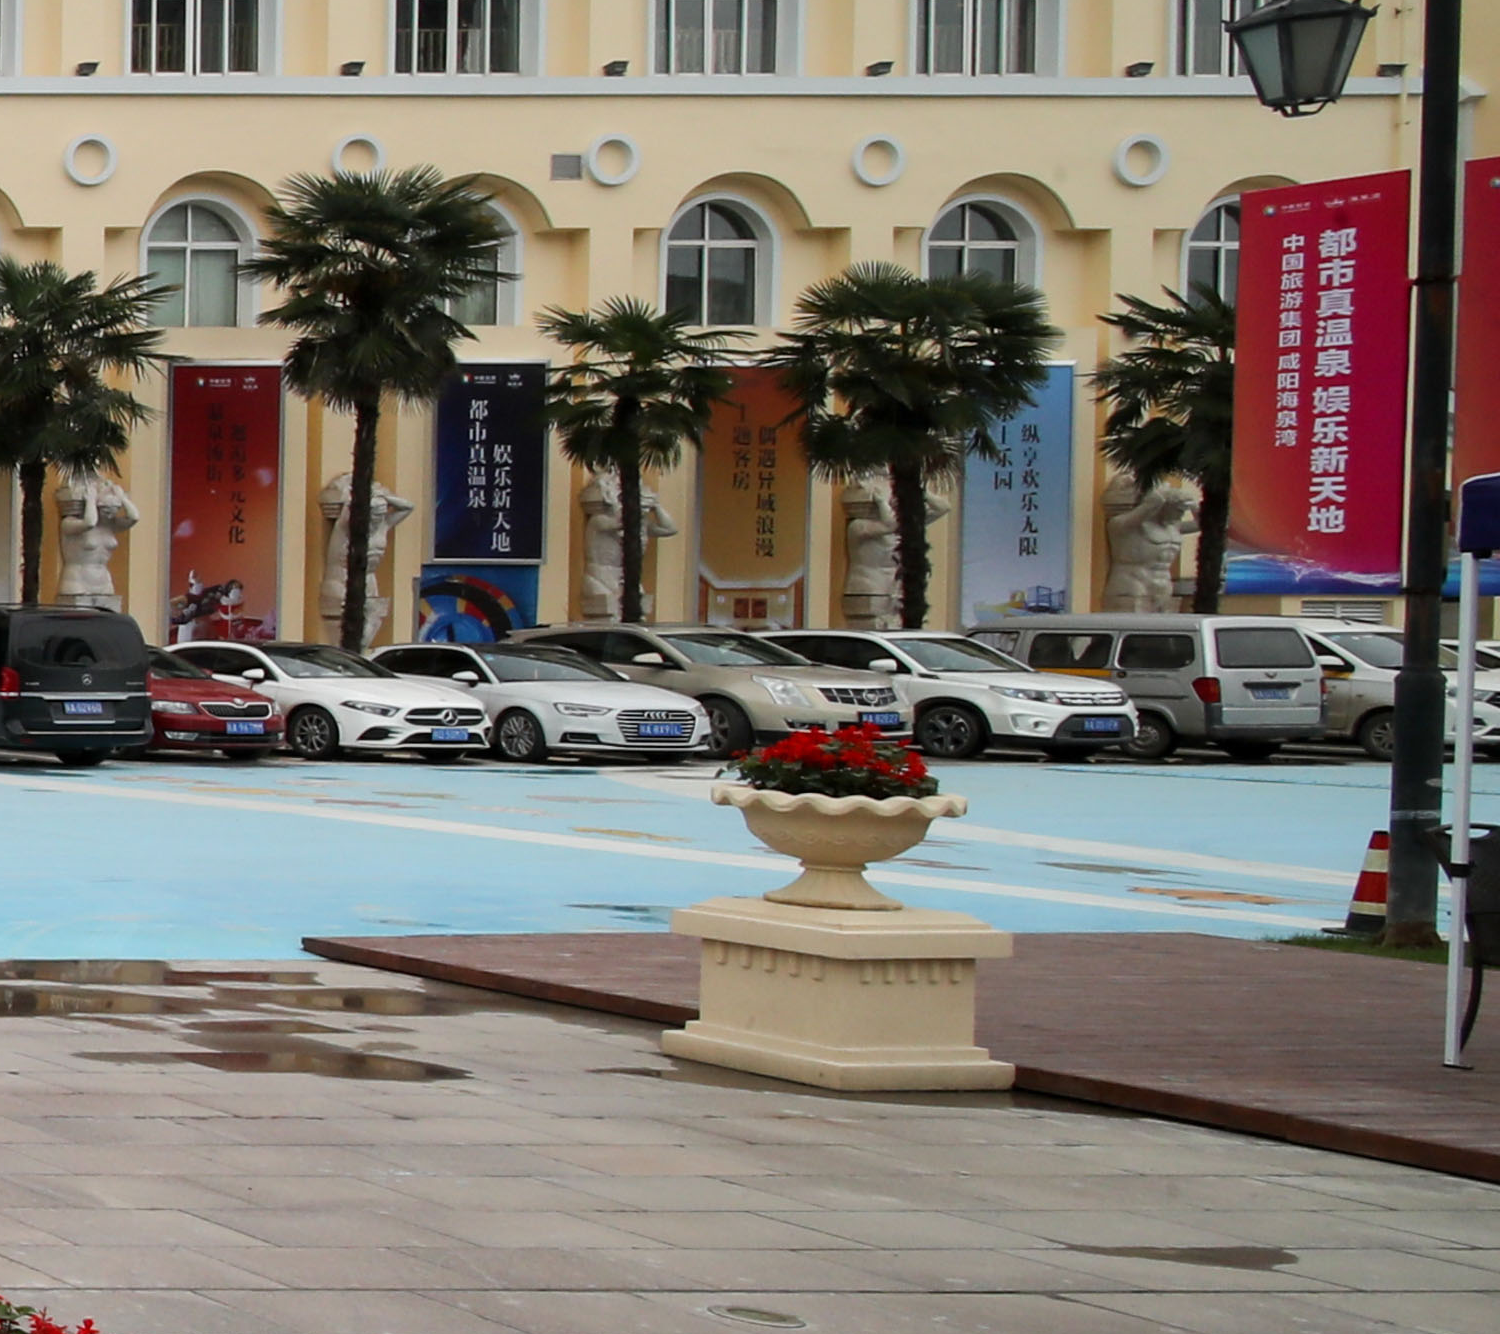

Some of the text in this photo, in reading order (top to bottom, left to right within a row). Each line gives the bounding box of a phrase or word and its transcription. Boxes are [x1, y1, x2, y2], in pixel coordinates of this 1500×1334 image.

[1275, 234, 1306, 447] 中国旅游集团 咸阳海泉湾
[1313, 227, 1357, 378] 都市真温泉
[467, 399, 489, 508] 都市真温泉
[490, 443, 513, 552] 娱乐新天地
[1019, 424, 1040, 557] 纵享欢乐无限
[1307, 385, 1351, 534] 娱乐新天地
